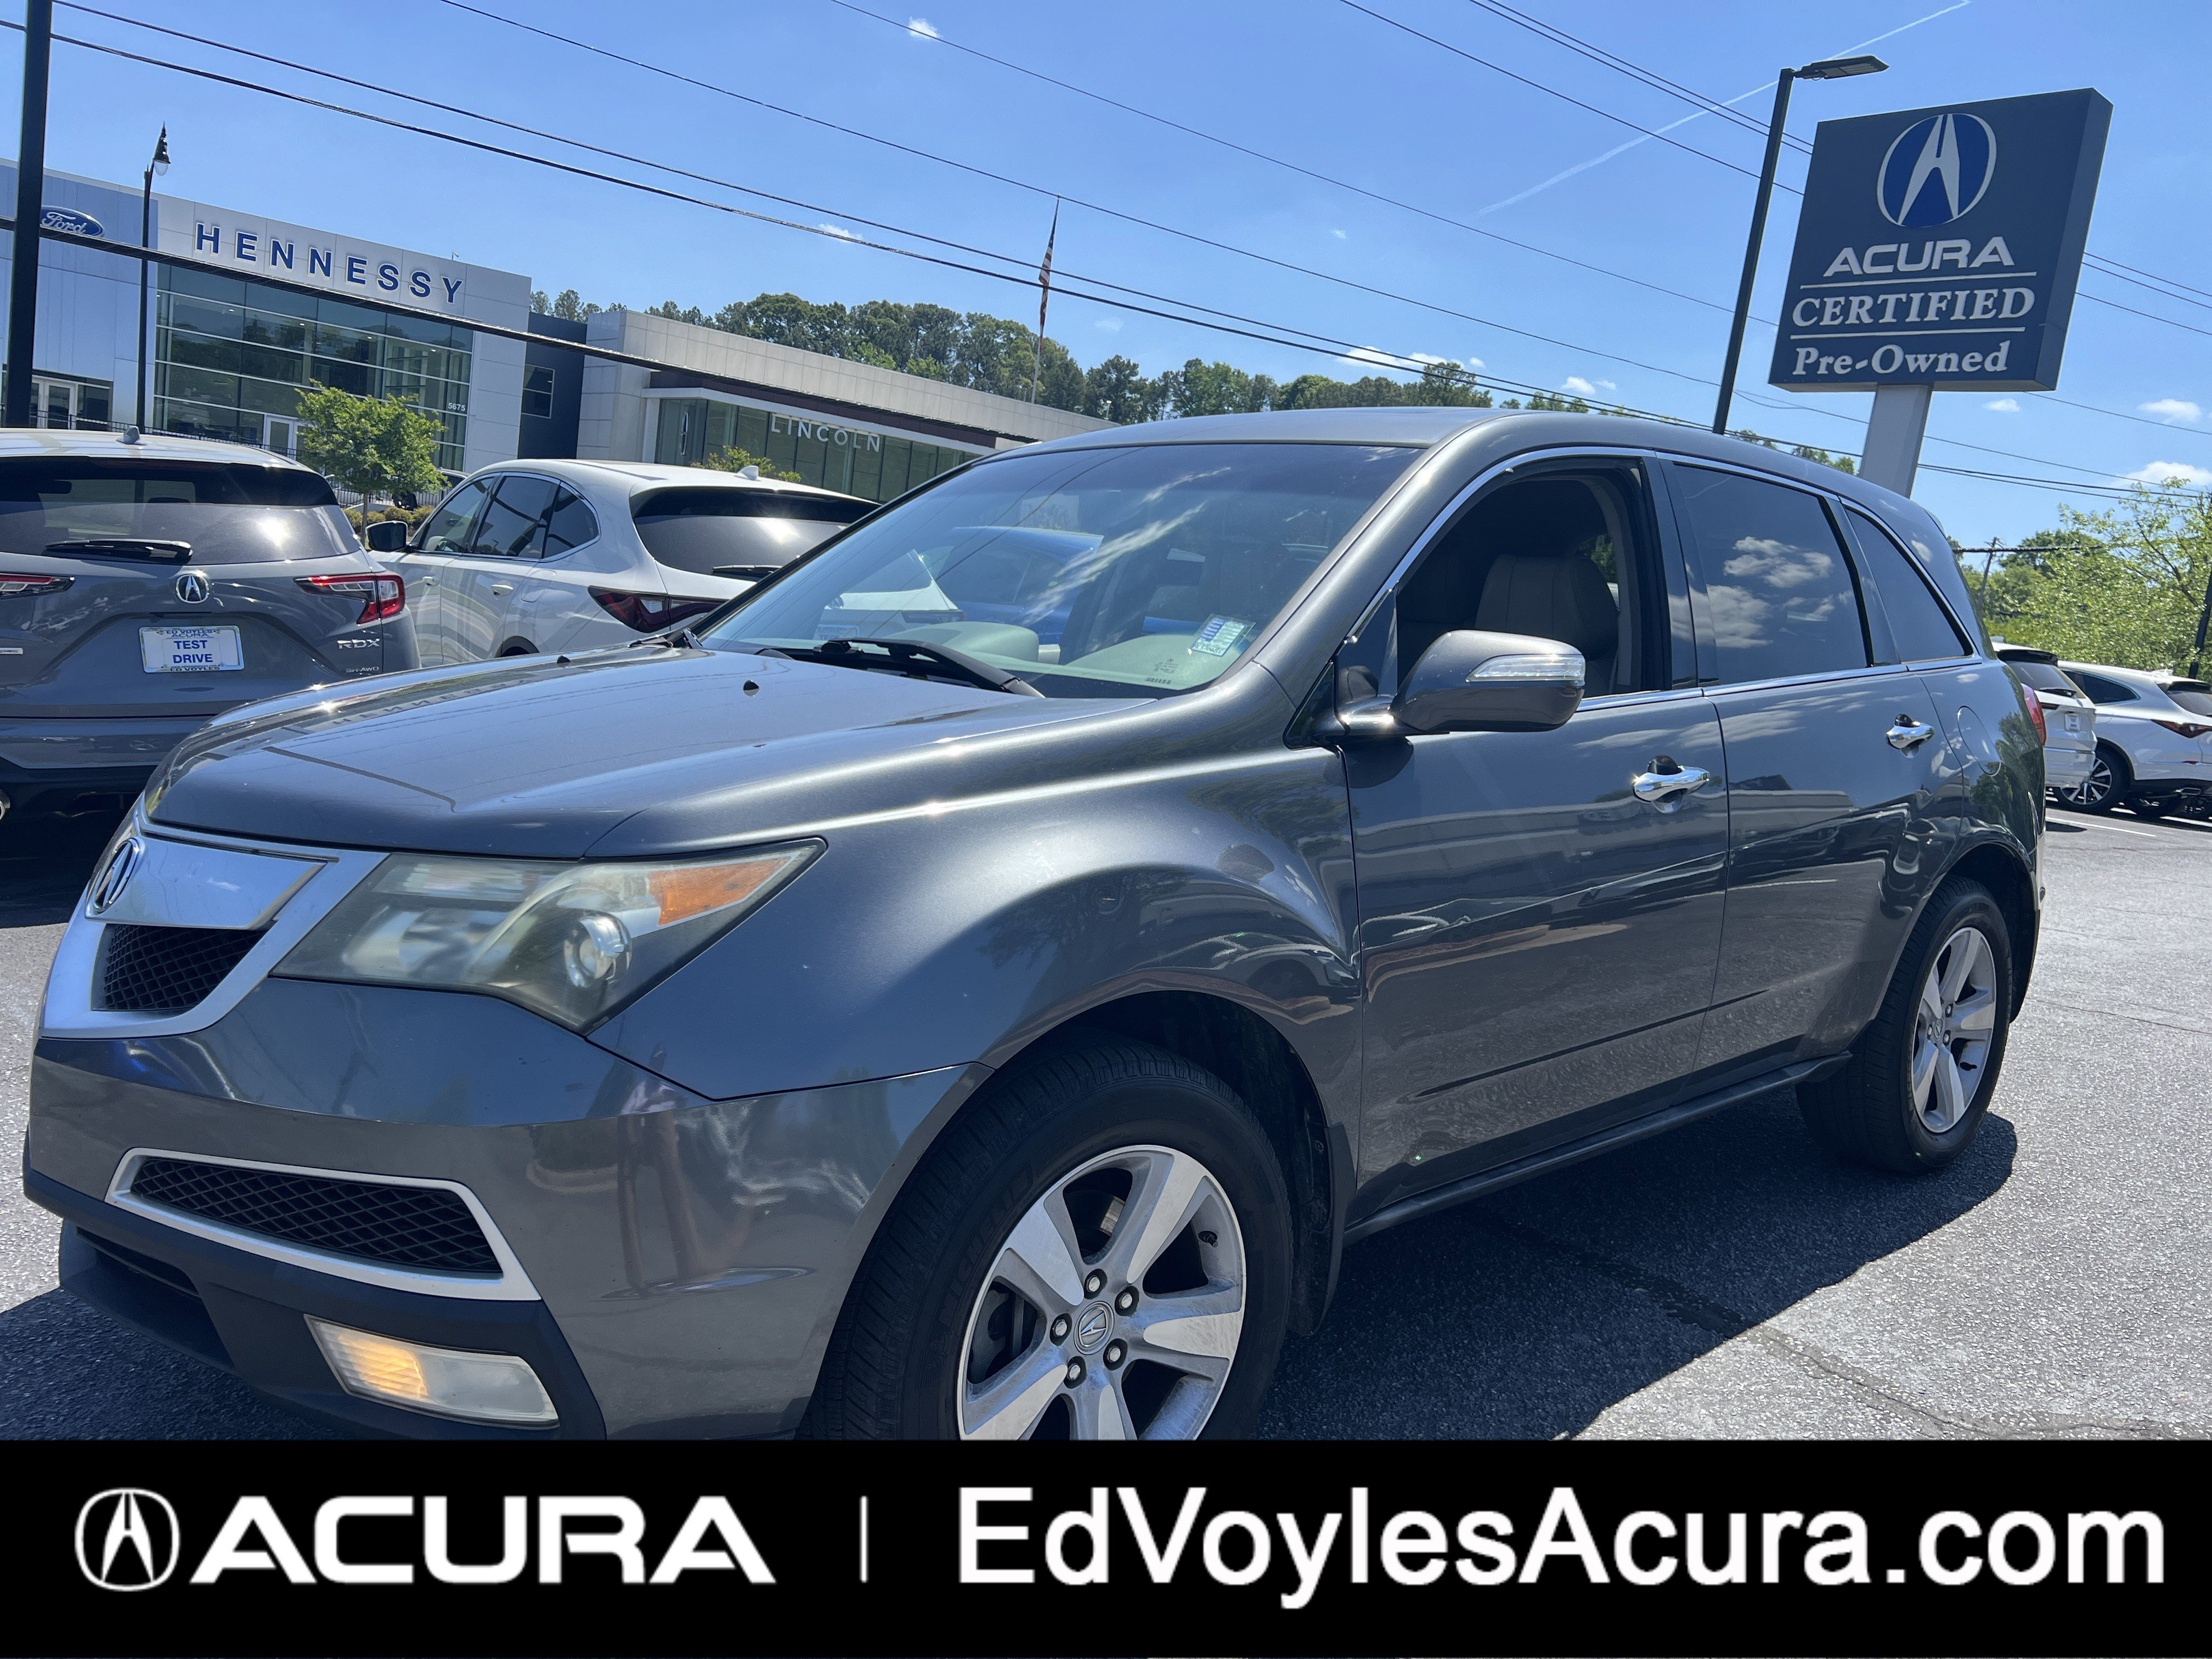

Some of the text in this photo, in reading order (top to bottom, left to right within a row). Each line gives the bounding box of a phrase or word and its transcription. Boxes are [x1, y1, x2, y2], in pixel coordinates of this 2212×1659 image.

[41, 212, 87, 234] Ford
[195, 222, 463, 304] HENNESSY
[1823, 236, 2015, 276] ACURA
[1792, 287, 2035, 327] CERTIFIED
[1792, 340, 2011, 375] Pre-Owned
[448, 402, 466, 411] 5675
[771, 415, 881, 453] LINCOLN
[173, 640, 207, 650] TEST
[173, 654, 213, 664] DRIVE
[337, 638, 380, 649] RDX
[939, 1169, 1029, 1328] MICHELIN
